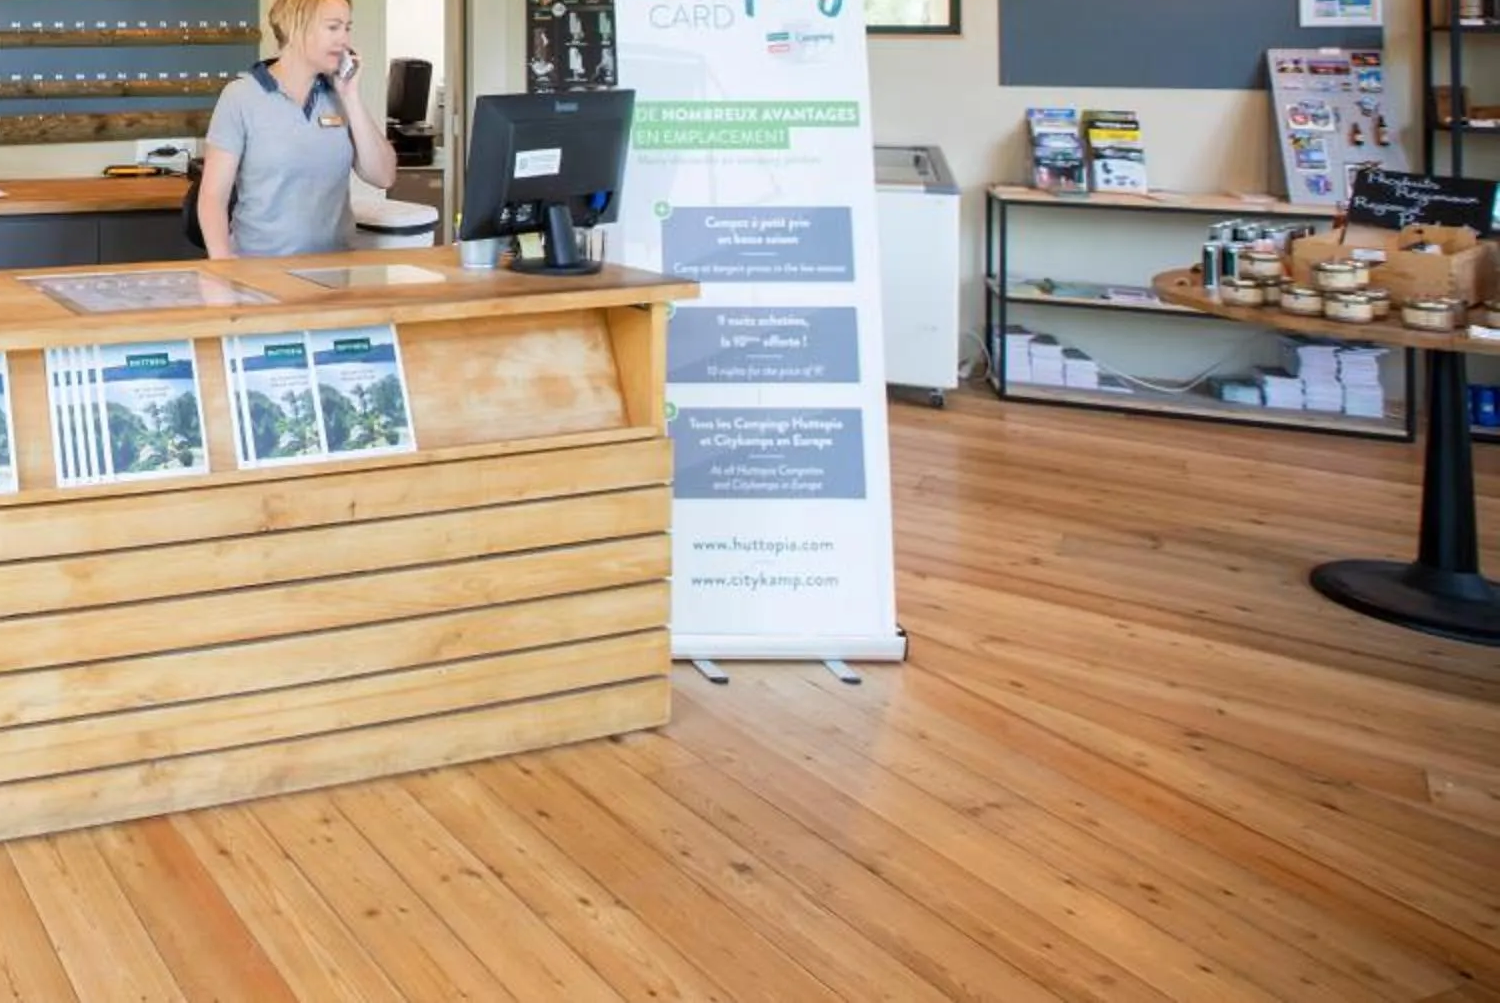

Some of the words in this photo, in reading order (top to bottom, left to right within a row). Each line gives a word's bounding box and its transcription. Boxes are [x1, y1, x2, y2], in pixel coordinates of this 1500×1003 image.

[649, 3, 735, 30] CARD
[661, 107, 758, 122] NOMBREUX
[761, 107, 857, 122] AVANTAGES
[637, 129, 660, 145] EN
[663, 129, 786, 145] EMPLACEMENT
[792, 416, 844, 434] Huttopia
[792, 433, 834, 450] Europe
[692, 536, 835, 556] www.huttopia.com
[691, 572, 840, 592] www.citykamp.com
